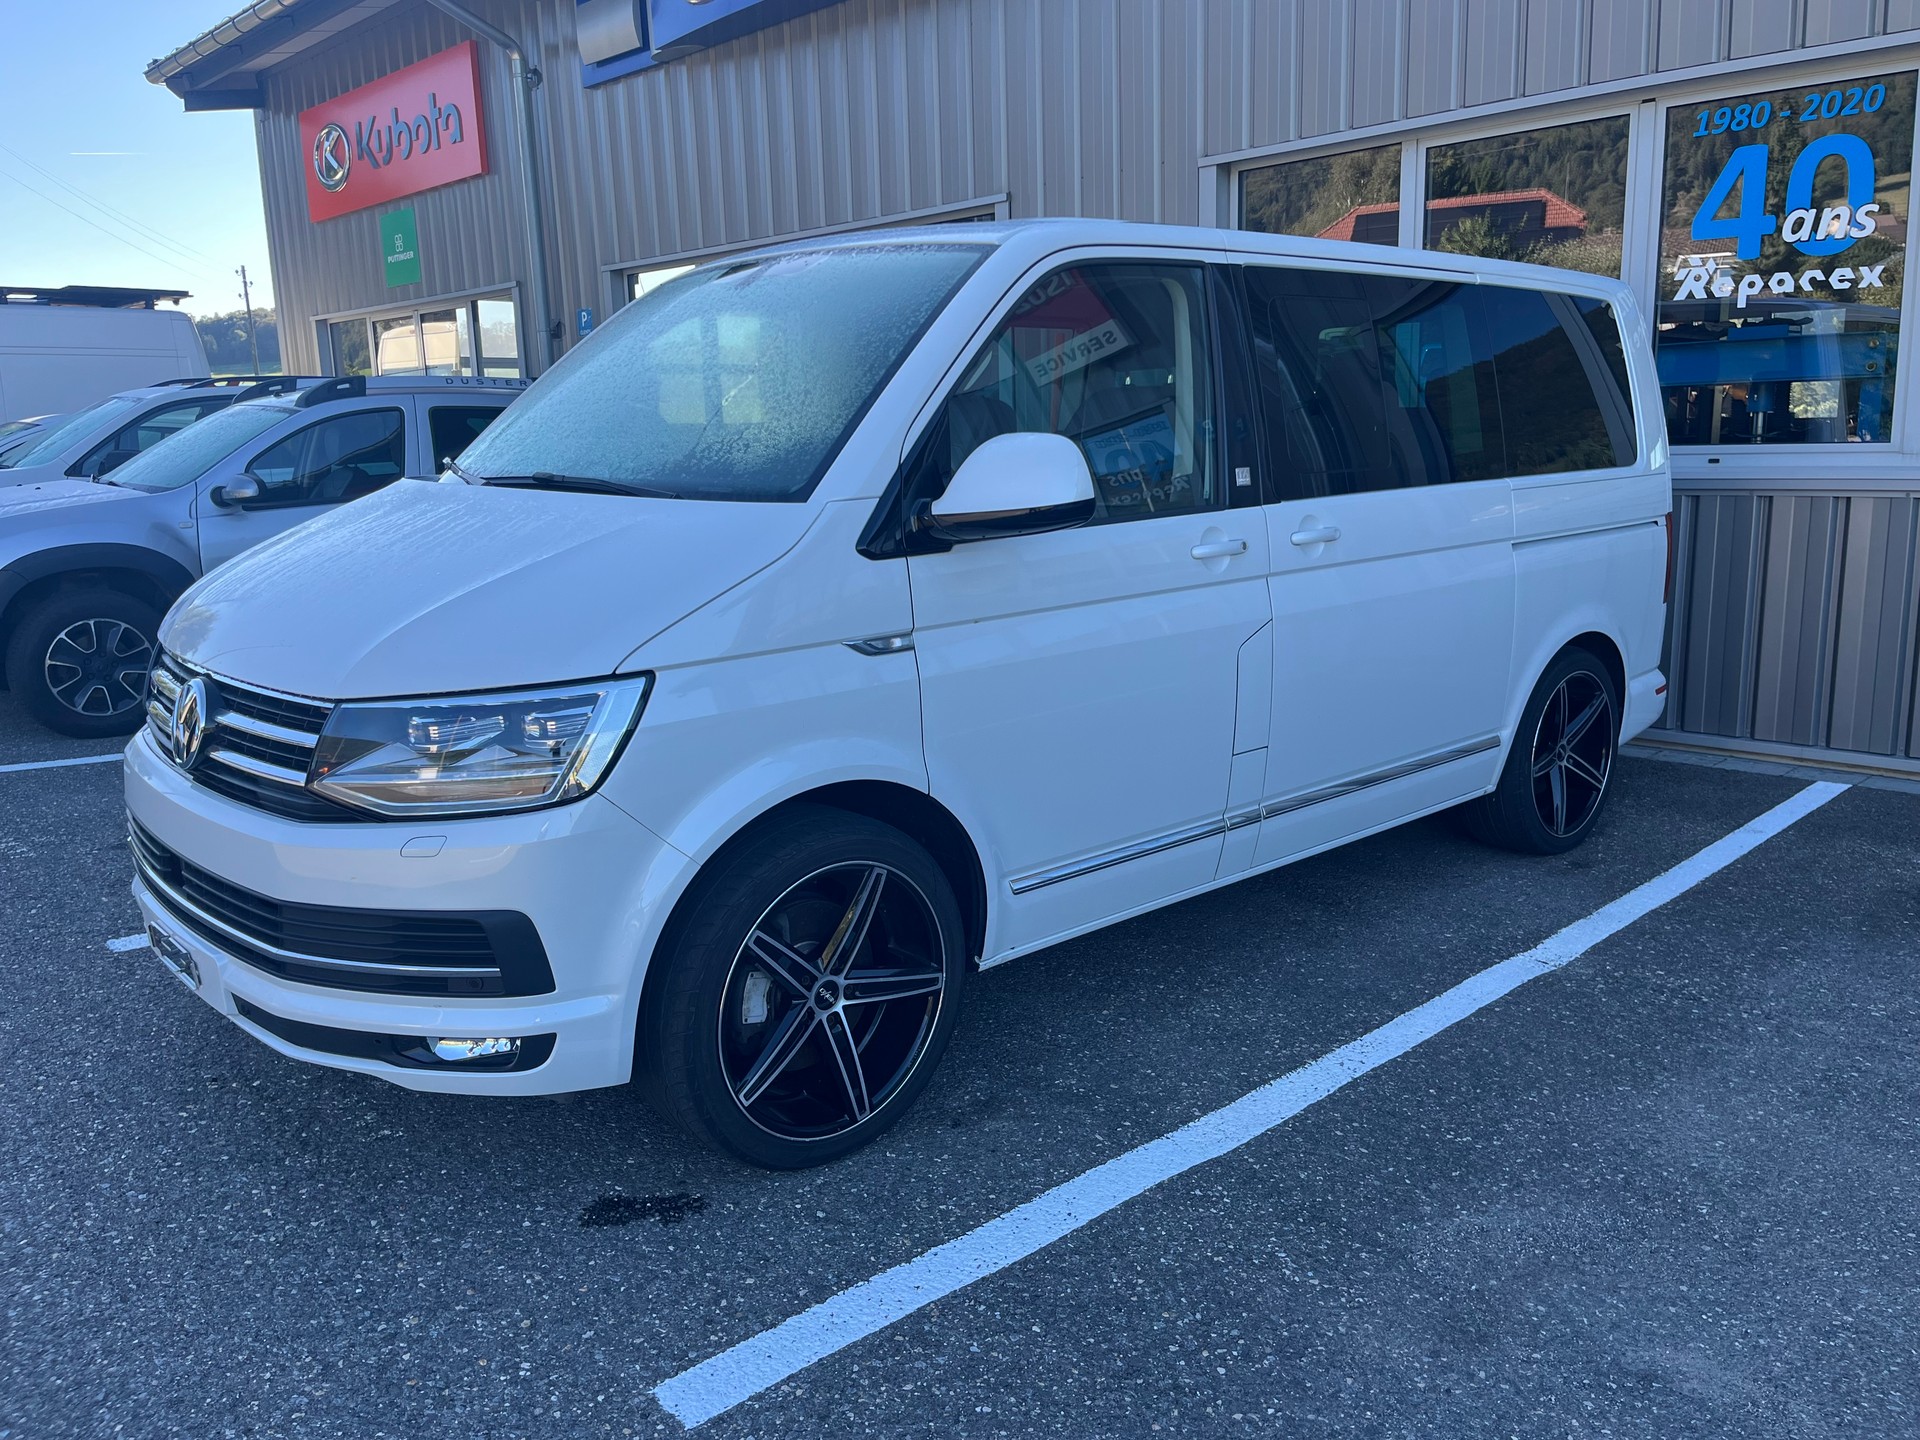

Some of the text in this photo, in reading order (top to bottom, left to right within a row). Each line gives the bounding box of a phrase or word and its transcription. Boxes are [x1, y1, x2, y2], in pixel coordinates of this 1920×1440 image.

[355, 92, 463, 169] Kubota
[1693, 100, 1772, 138] 1980
[1799, 83, 1886, 122] 2020
[1691, 133, 1880, 261] 40 ans
[1673, 257, 1885, 309] Reparex
[581, 311, 588, 327] P
[445, 377, 528, 387] DUSTER
